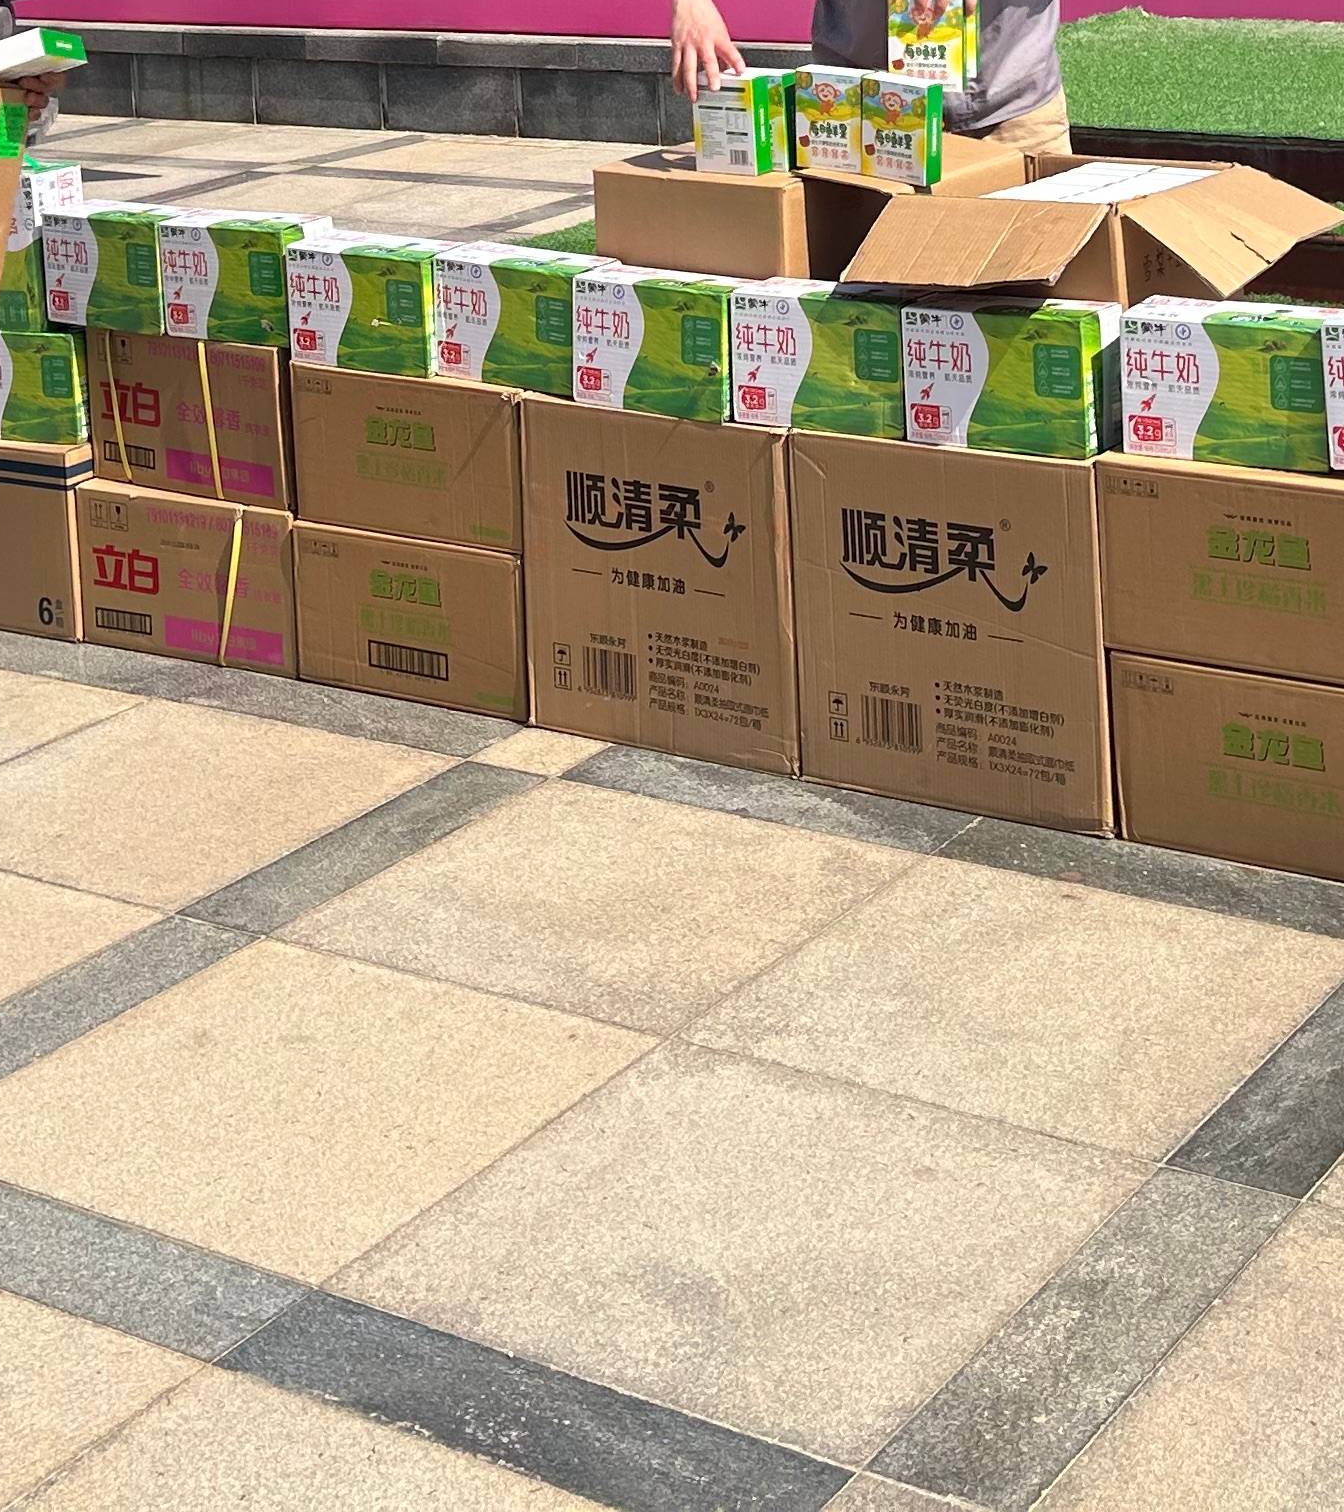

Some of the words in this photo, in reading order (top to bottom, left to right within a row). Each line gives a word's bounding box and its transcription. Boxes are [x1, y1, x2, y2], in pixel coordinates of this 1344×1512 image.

[46, 238, 89, 265] 纯牛奶
[163, 249, 208, 277] 纯牛奶
[290, 273, 340, 303] 纯牛奶
[437, 284, 487, 317] 纯牛奶
[576, 305, 630, 339] 纯牛奶
[920, 314, 942, 326] 蒙牛
[1140, 321, 1167, 337] 蒙牛
[736, 322, 796, 356] 纯牛奶
[908, 339, 972, 373] 纯牛奶
[1126, 347, 1200, 384] 纯牛奶
[99, 378, 161, 427] 立白
[565, 470, 701, 539] 顺清柔
[841, 508, 995, 581] 顺清柔
[92, 544, 160, 595] 立白
[611, 567, 686, 595] 为健康加油
[38, 597, 54, 625] 6
[893, 611, 977, 641] 为健康加油
